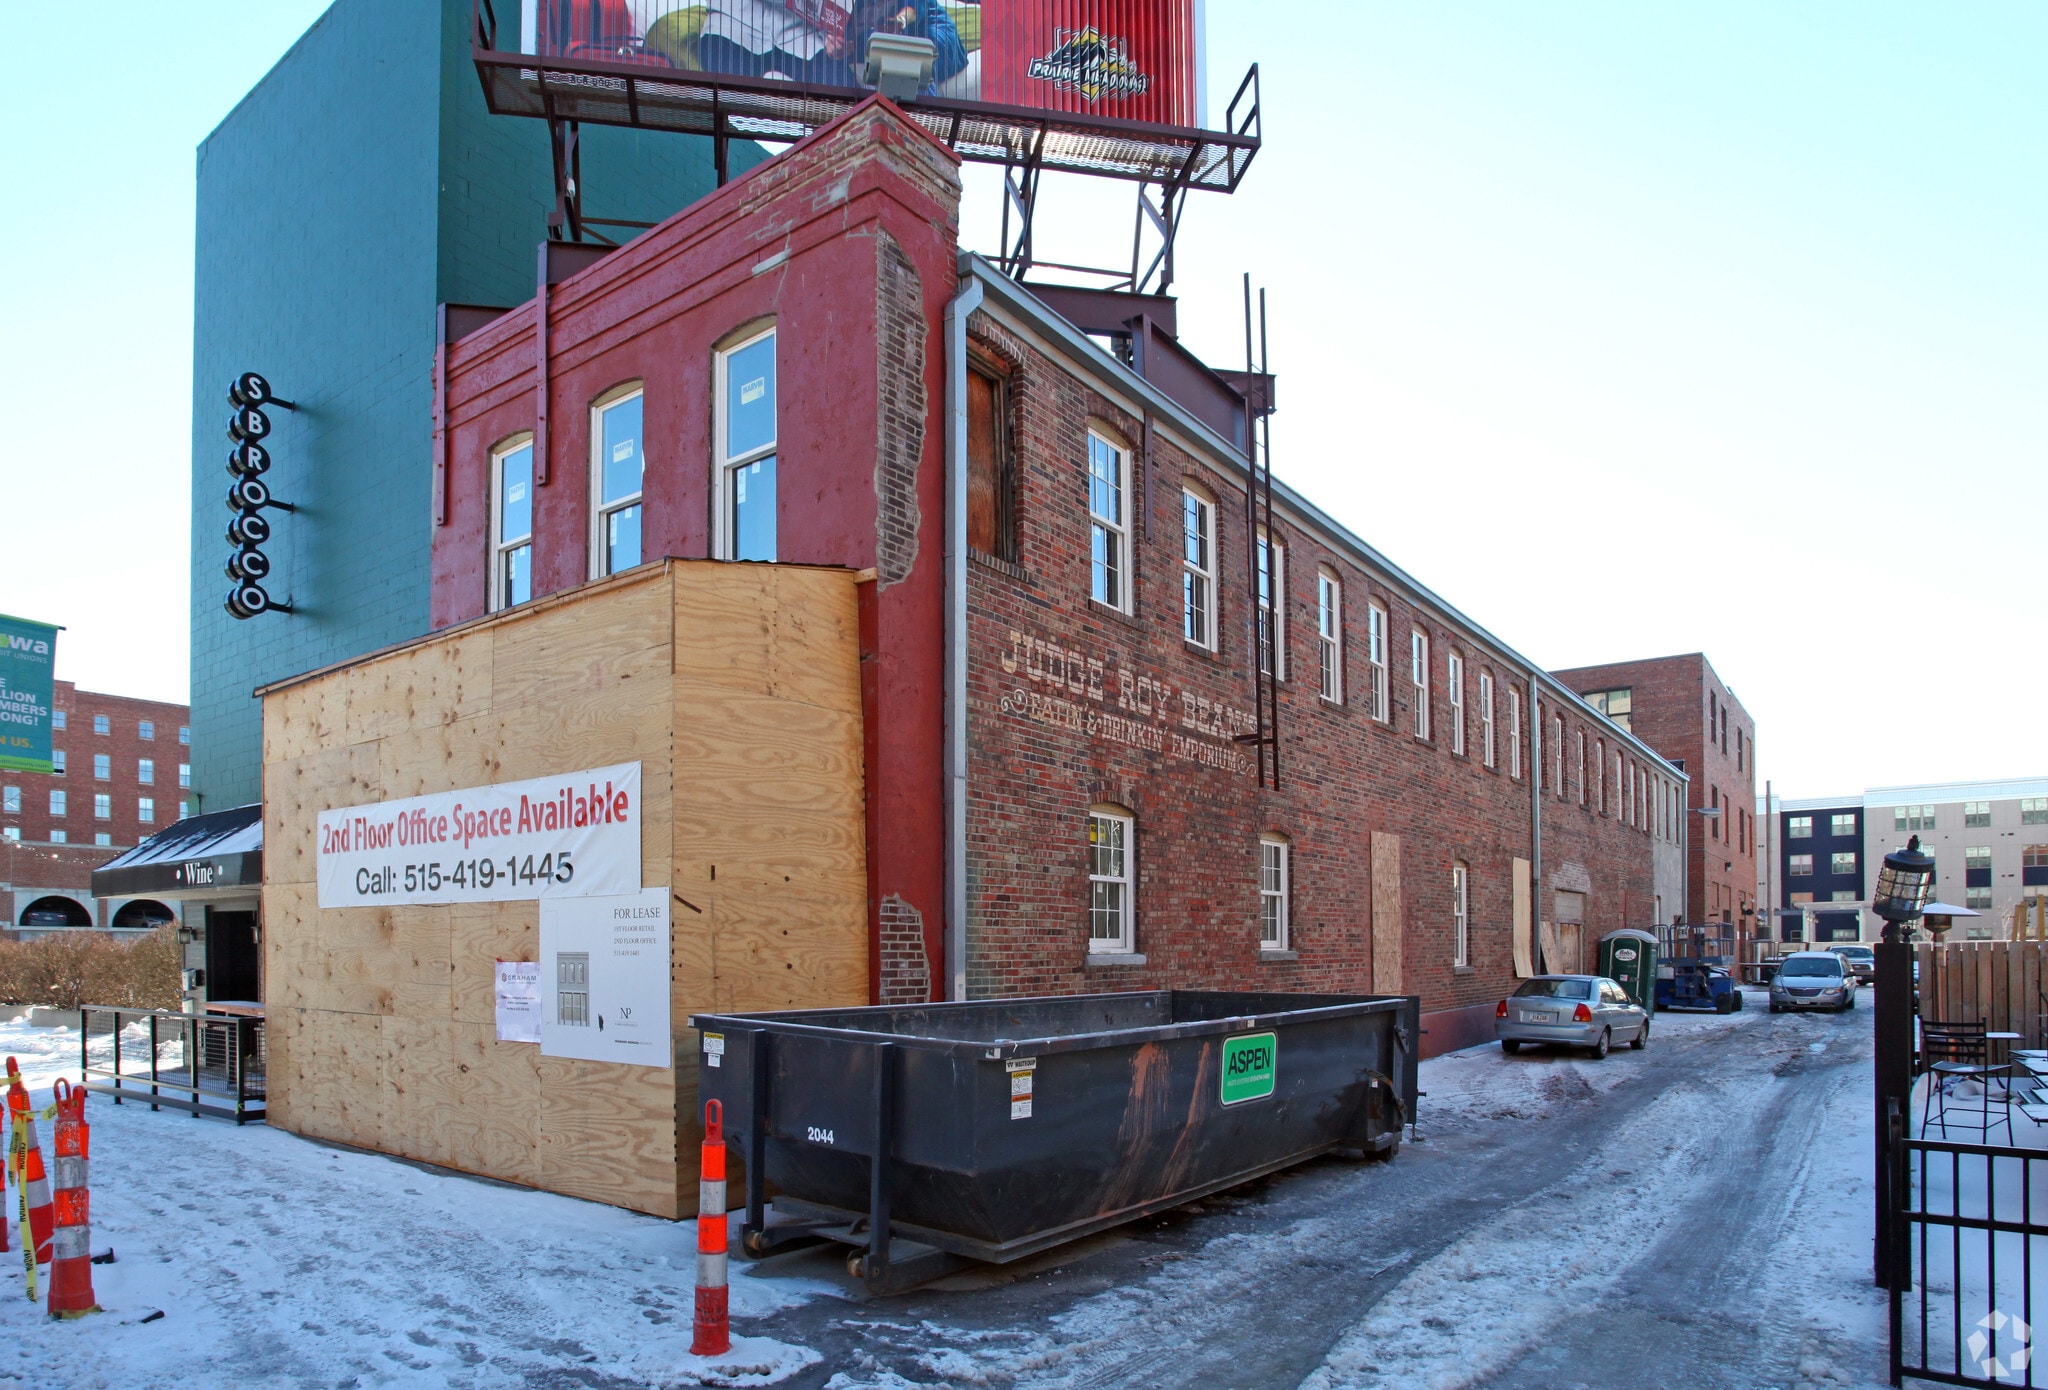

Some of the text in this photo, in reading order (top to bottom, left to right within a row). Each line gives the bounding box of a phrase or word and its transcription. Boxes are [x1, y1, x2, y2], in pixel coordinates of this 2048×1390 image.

[241, 377, 266, 611] SBROCCO
[14, 652, 48, 665] UNIONS
[1001, 630, 1103, 702] JUDGE
[1117, 668, 1171, 720] ROY
[1171, 733, 1237, 772] EMPORIUM
[322, 781, 629, 854] 2nd Floor Office Space Available
[184, 862, 214, 885] Wine
[355, 851, 574, 895] Call: 515-419-1445
[613, 907, 661, 919] FOR LEASE
[1228, 1046, 1271, 1075] ASPEN
[807, 1126, 834, 1145] 2044
